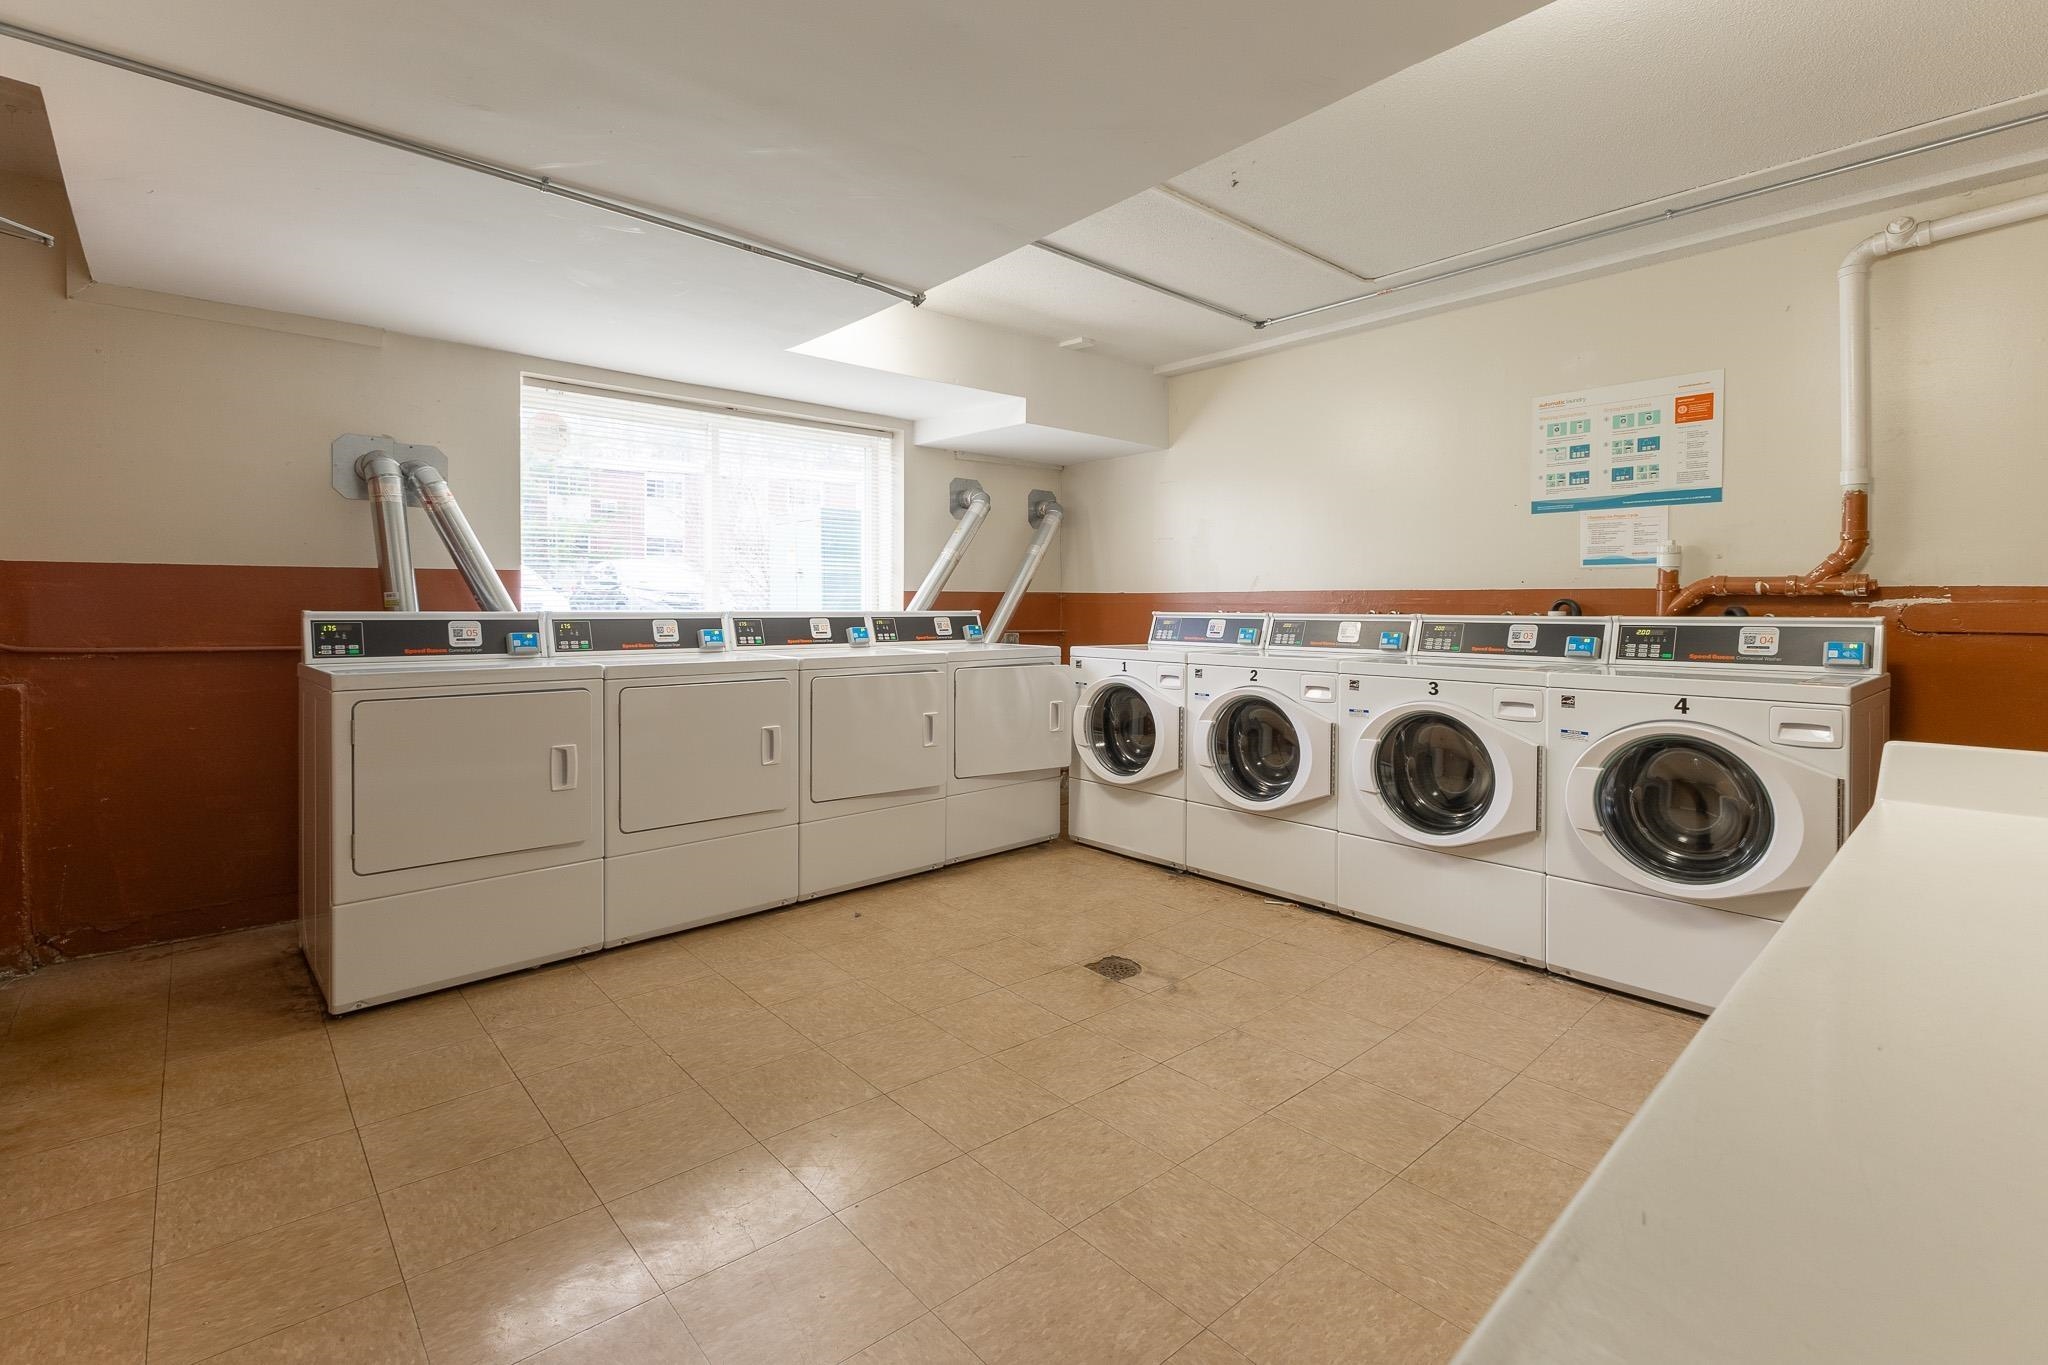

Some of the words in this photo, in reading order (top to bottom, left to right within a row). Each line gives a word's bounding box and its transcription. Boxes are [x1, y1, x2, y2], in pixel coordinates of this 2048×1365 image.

[1538, 400, 1565, 408] automatic
[1524, 632, 1534, 640] 03
[1759, 636, 1774, 644] 04
[1122, 661, 1128, 672] 1
[1250, 670, 1258, 682] 2
[1428, 681, 1439, 696] 3
[1674, 698, 1690, 714] 4
